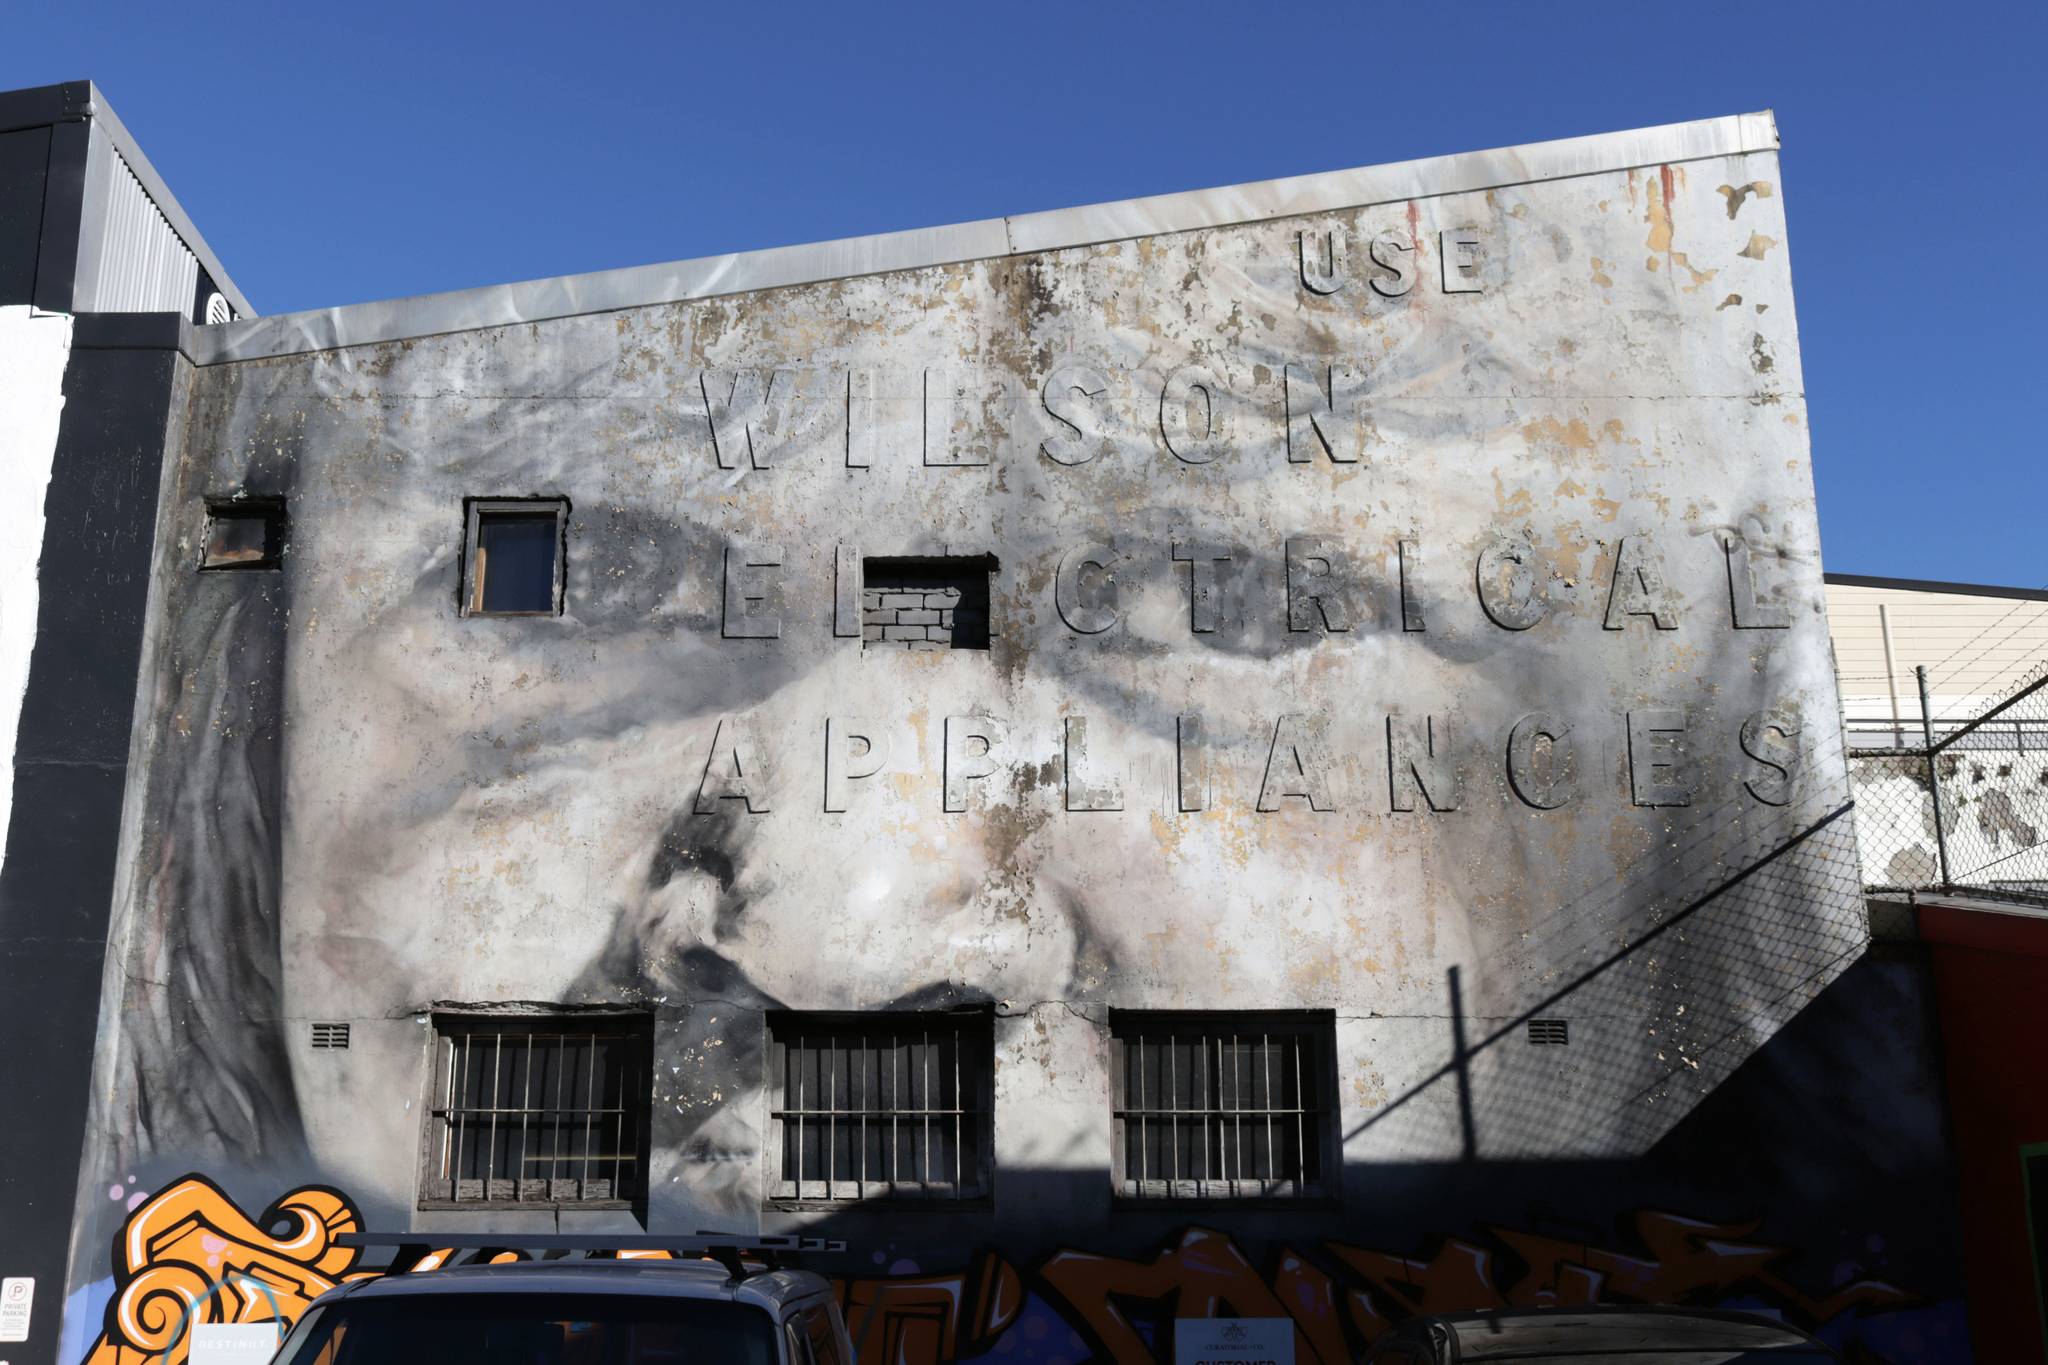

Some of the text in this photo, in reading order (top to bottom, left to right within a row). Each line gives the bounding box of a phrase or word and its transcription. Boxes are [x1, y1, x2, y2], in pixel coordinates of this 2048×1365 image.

[1297, 229, 1484, 297] USE
[699, 364, 1358, 470] WILSON
[692, 710, 1802, 813] APPLIANCES
